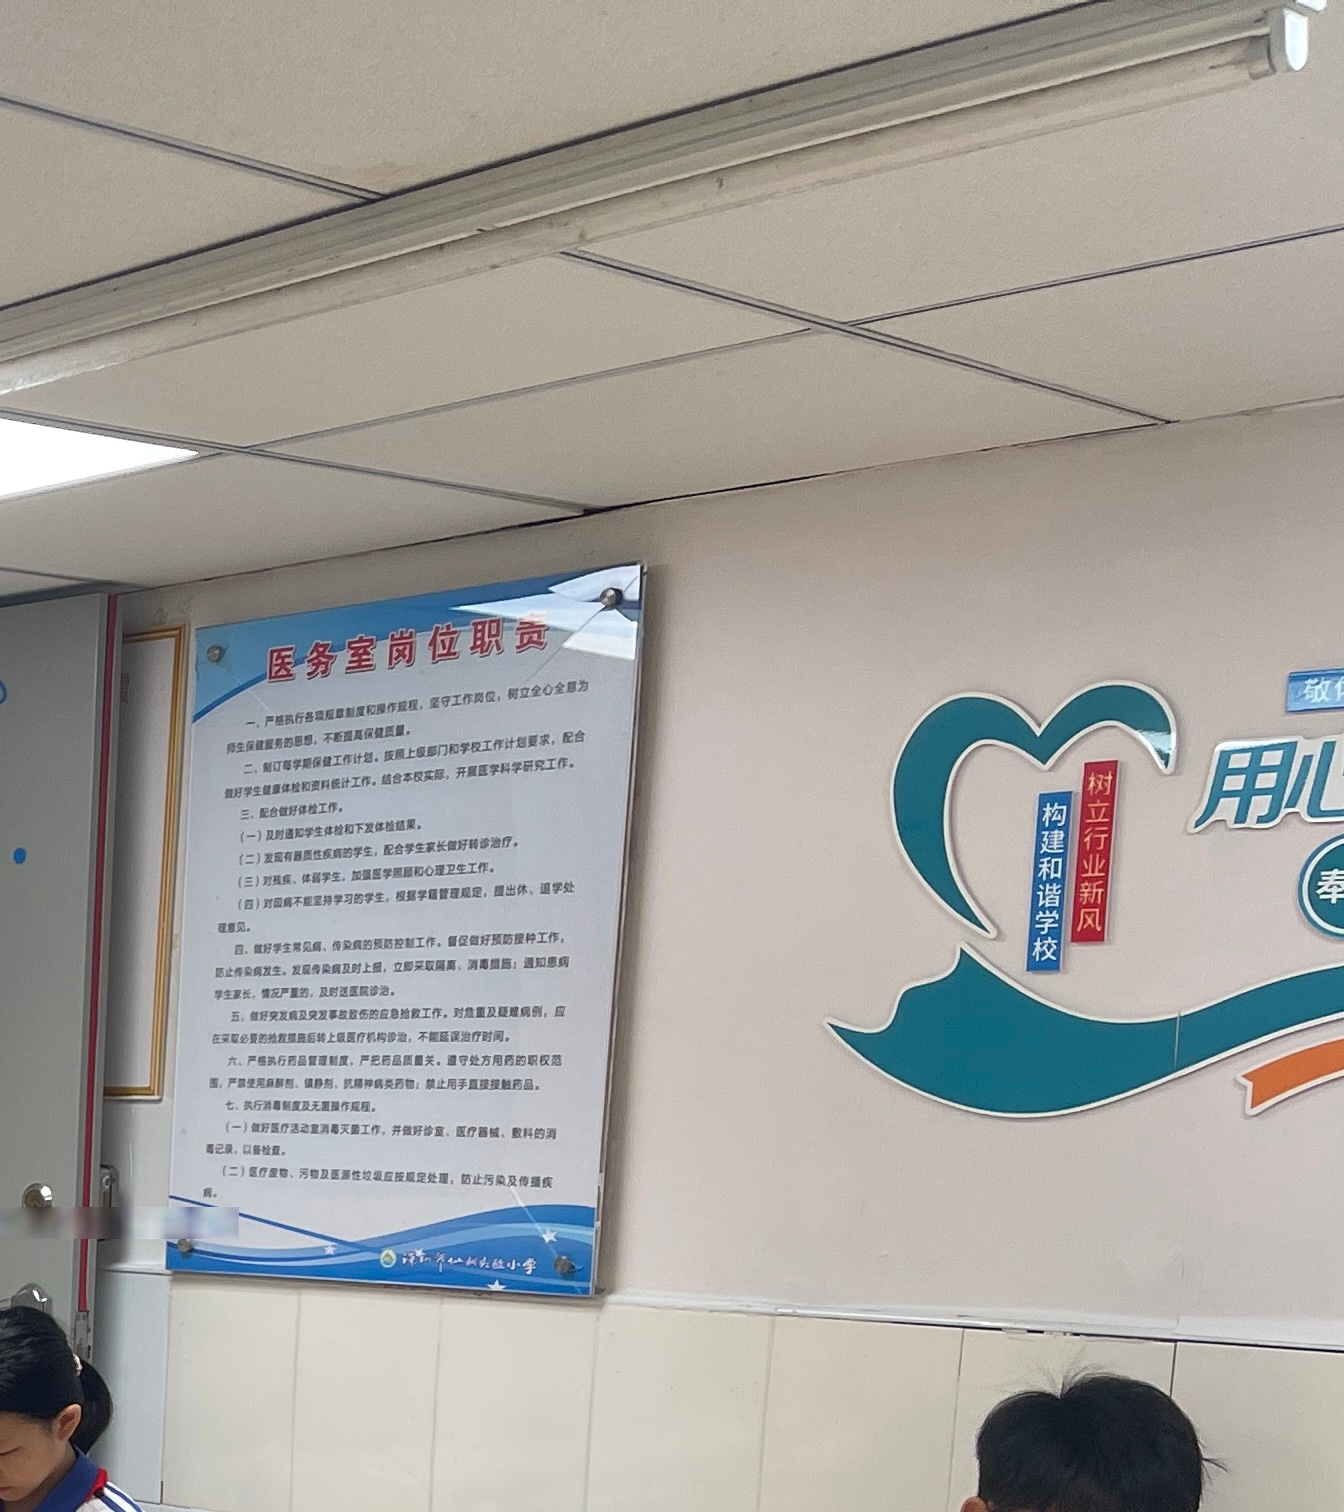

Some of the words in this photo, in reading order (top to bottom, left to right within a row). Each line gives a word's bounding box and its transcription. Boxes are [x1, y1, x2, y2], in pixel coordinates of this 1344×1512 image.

[267, 612, 550, 683] 医务室岗位职责
[1031, 801, 1067, 963] 构建和谐学校
[1076, 770, 1114, 933] 树立行业新风
